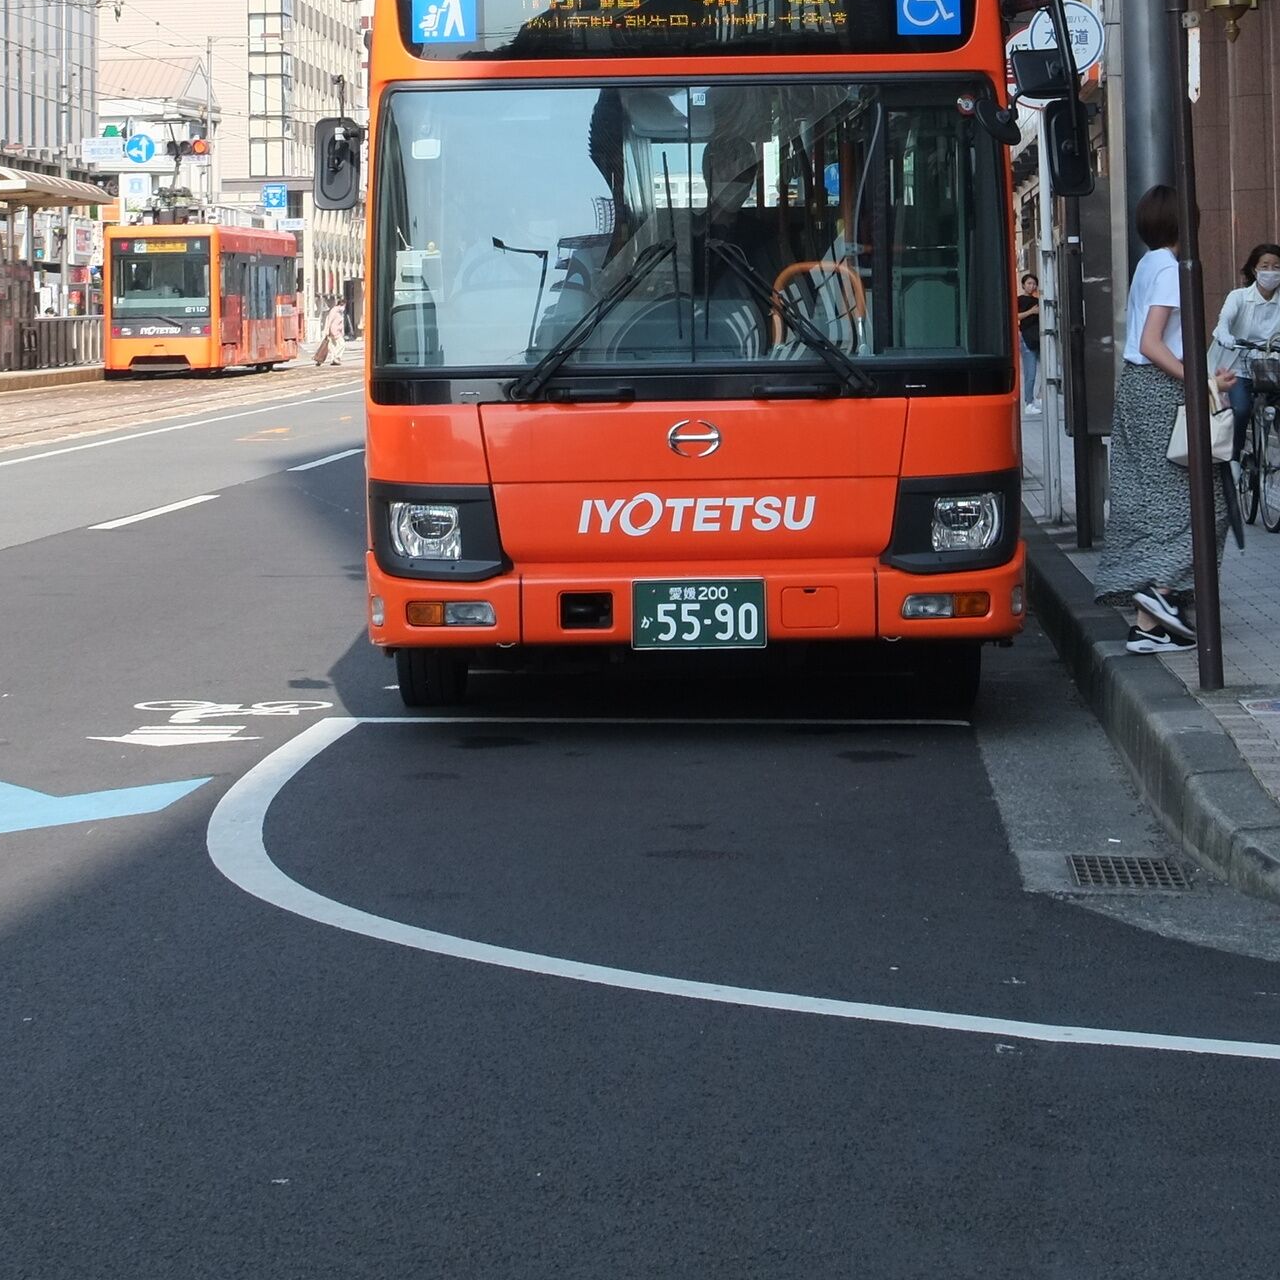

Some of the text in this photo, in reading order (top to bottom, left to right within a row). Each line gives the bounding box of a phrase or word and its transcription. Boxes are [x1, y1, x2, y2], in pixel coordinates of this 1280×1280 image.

[1045, 28, 1089, 46] 大道
[139, 325, 181, 336] IYOTETSU
[577, 492, 816, 537] IYOTETSU
[640, 602, 759, 641] か 55-90
